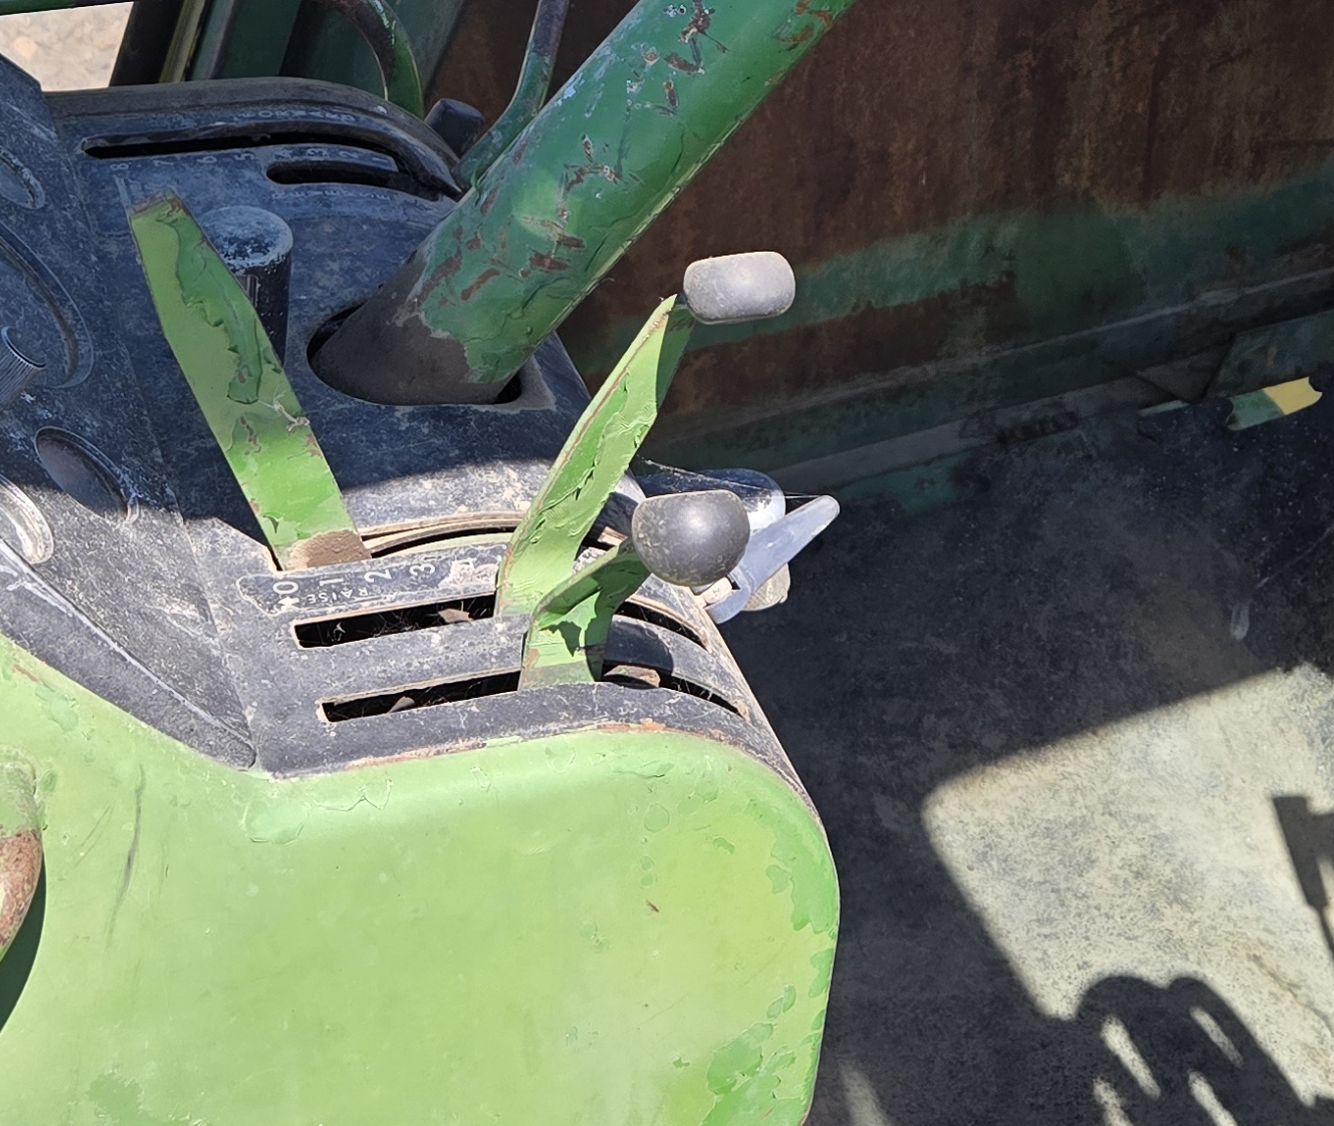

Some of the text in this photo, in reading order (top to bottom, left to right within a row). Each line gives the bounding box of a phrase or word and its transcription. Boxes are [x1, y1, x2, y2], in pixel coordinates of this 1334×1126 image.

[364, 568, 393, 584] 2
[409, 563, 436, 577] 3
[306, 586, 370, 605] RAISE
